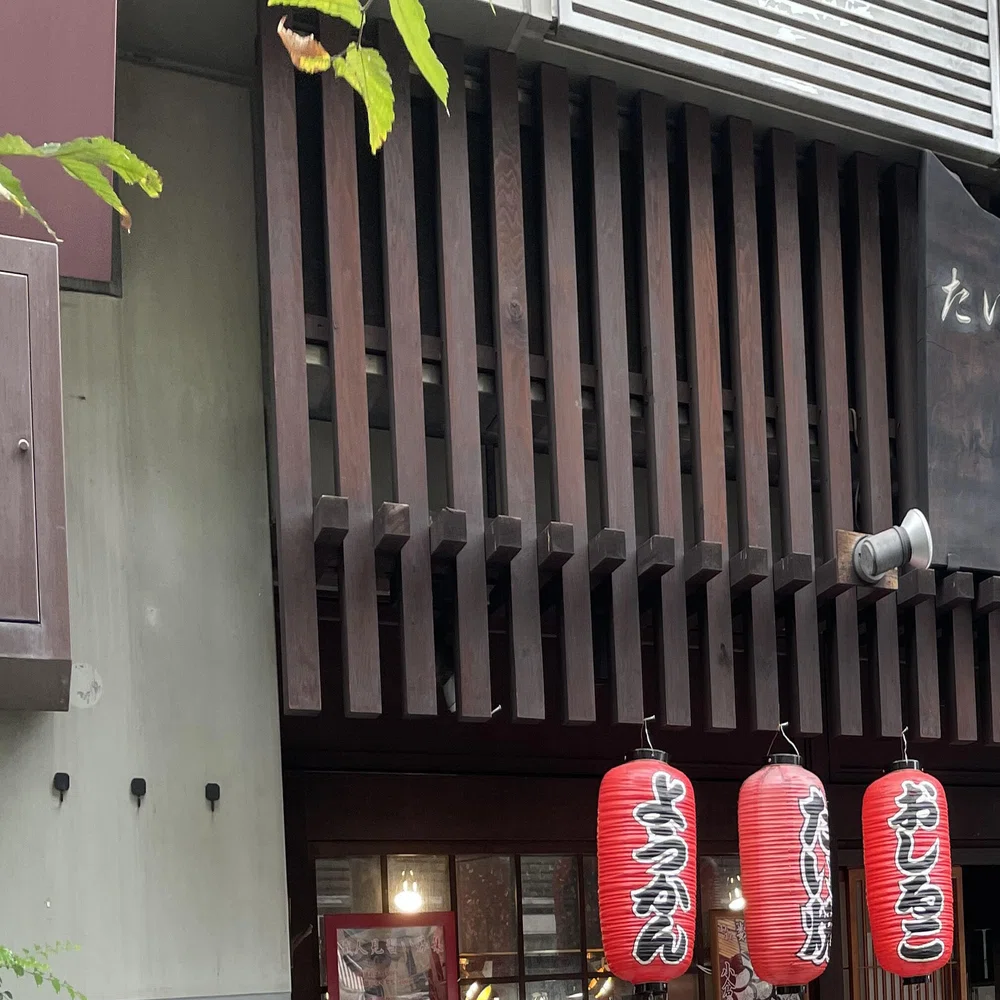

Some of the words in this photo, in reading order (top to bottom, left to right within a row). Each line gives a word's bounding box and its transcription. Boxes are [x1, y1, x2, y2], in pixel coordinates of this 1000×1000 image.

[631, 771, 692, 965] ようかん
[888, 780, 946, 962] おしるこ
